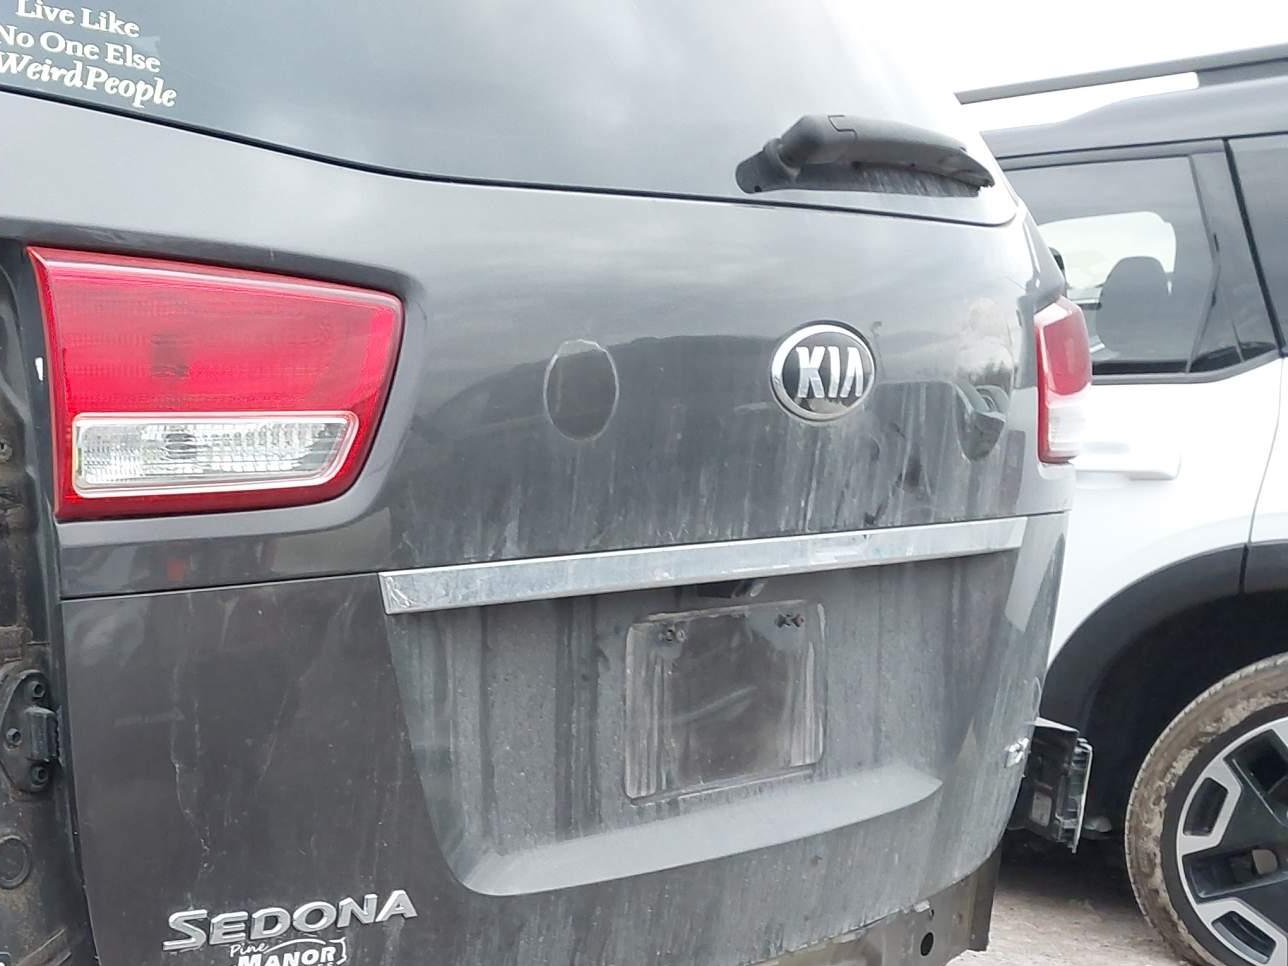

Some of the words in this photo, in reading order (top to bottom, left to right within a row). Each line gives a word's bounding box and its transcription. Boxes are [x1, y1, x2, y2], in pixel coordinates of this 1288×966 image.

[16, 0, 75, 24] Live
[80, 7, 140, 38] Like
[40, 31, 99, 61] One
[104, 42, 162, 73] Else
[795, 346, 864, 398] KIA
[162, 889, 418, 951] SEDONA
[229, 942, 269, 958] Pine
